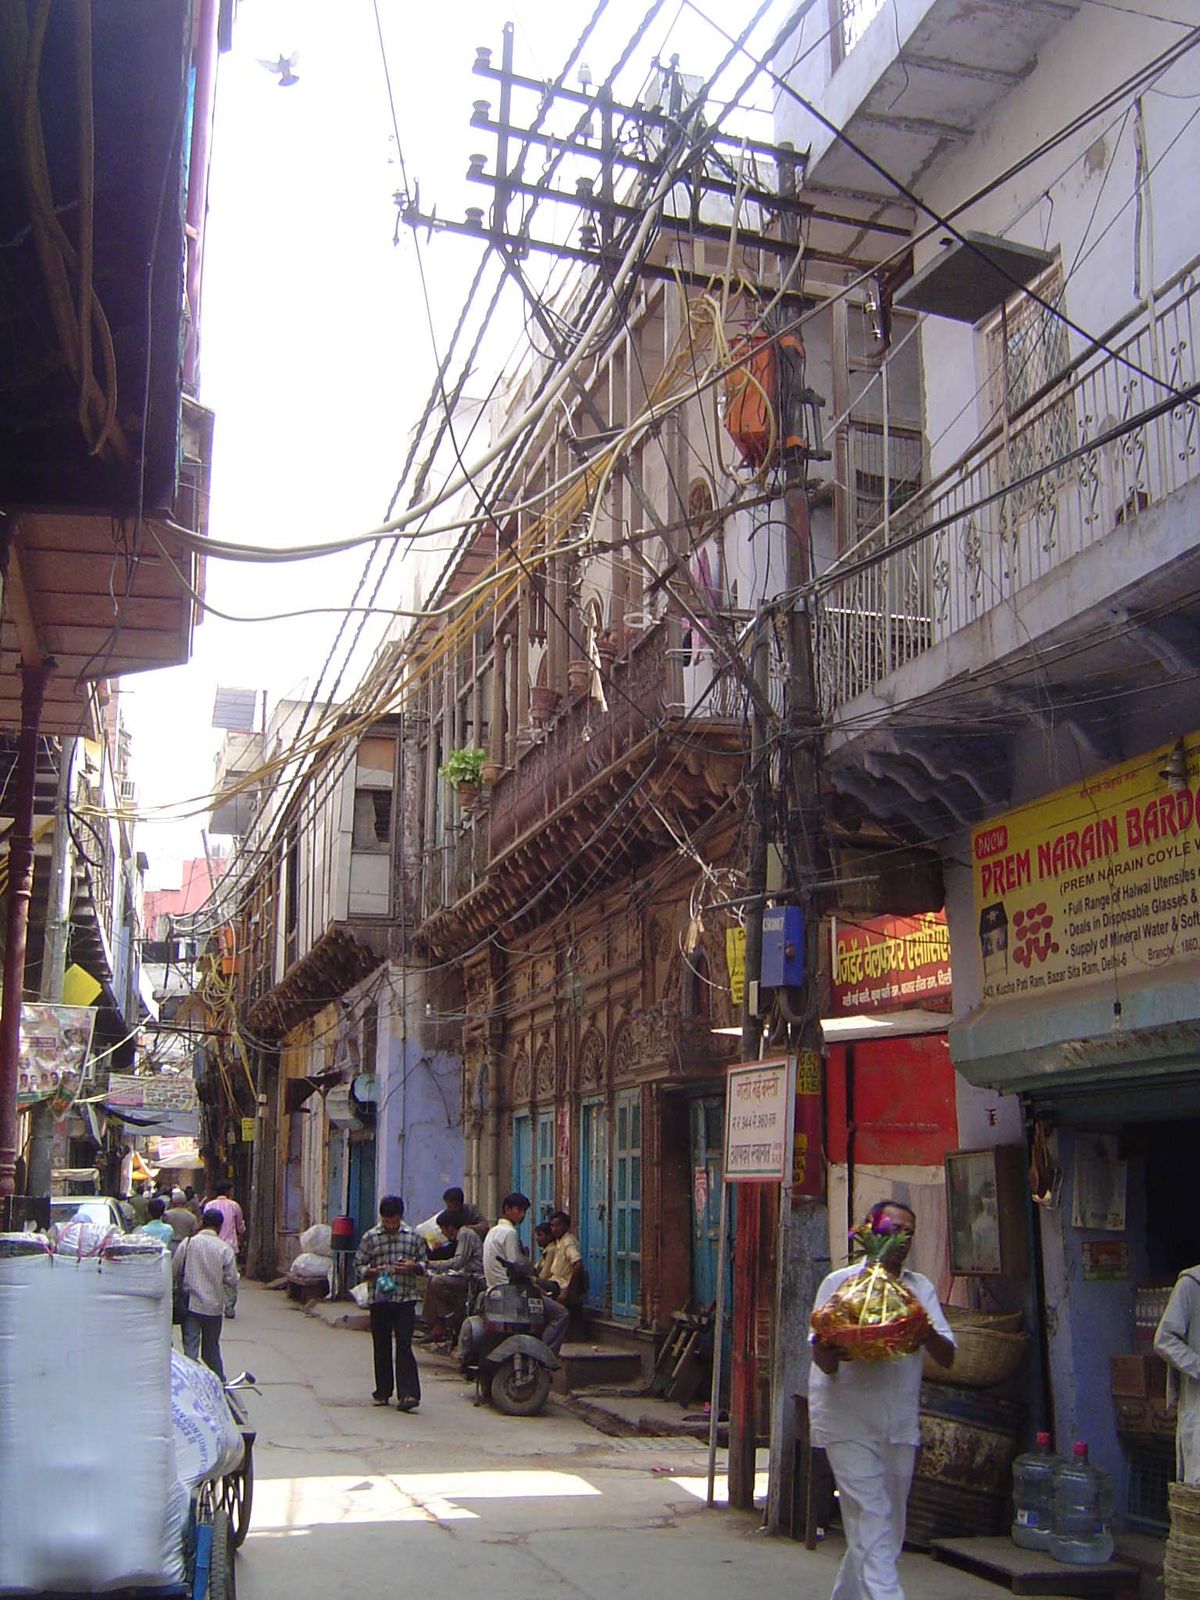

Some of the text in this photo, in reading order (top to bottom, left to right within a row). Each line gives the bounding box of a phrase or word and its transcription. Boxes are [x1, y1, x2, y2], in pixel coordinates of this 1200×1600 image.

[981, 785, 1200, 898] PREM NARAIN BARD
[1060, 873, 1095, 896] (PREM
[1098, 857, 1144, 880] NARAIN
[1147, 841, 1191, 866] COYLE
[1068, 899, 1082, 916] Full
[1084, 893, 1109, 911] Range
[1111, 886, 1121, 903] of
[1122, 880, 1151, 900] Halwai
[1069, 888, 1198, 937] Deals in Disposable Glasses &
[1070, 939, 1098, 957] Supply
[1100, 935, 1109, 950] of
[1110, 927, 1141, 946] Mineral
[1143, 921, 1169, 939] Water
[1171, 916, 1179, 932] &
